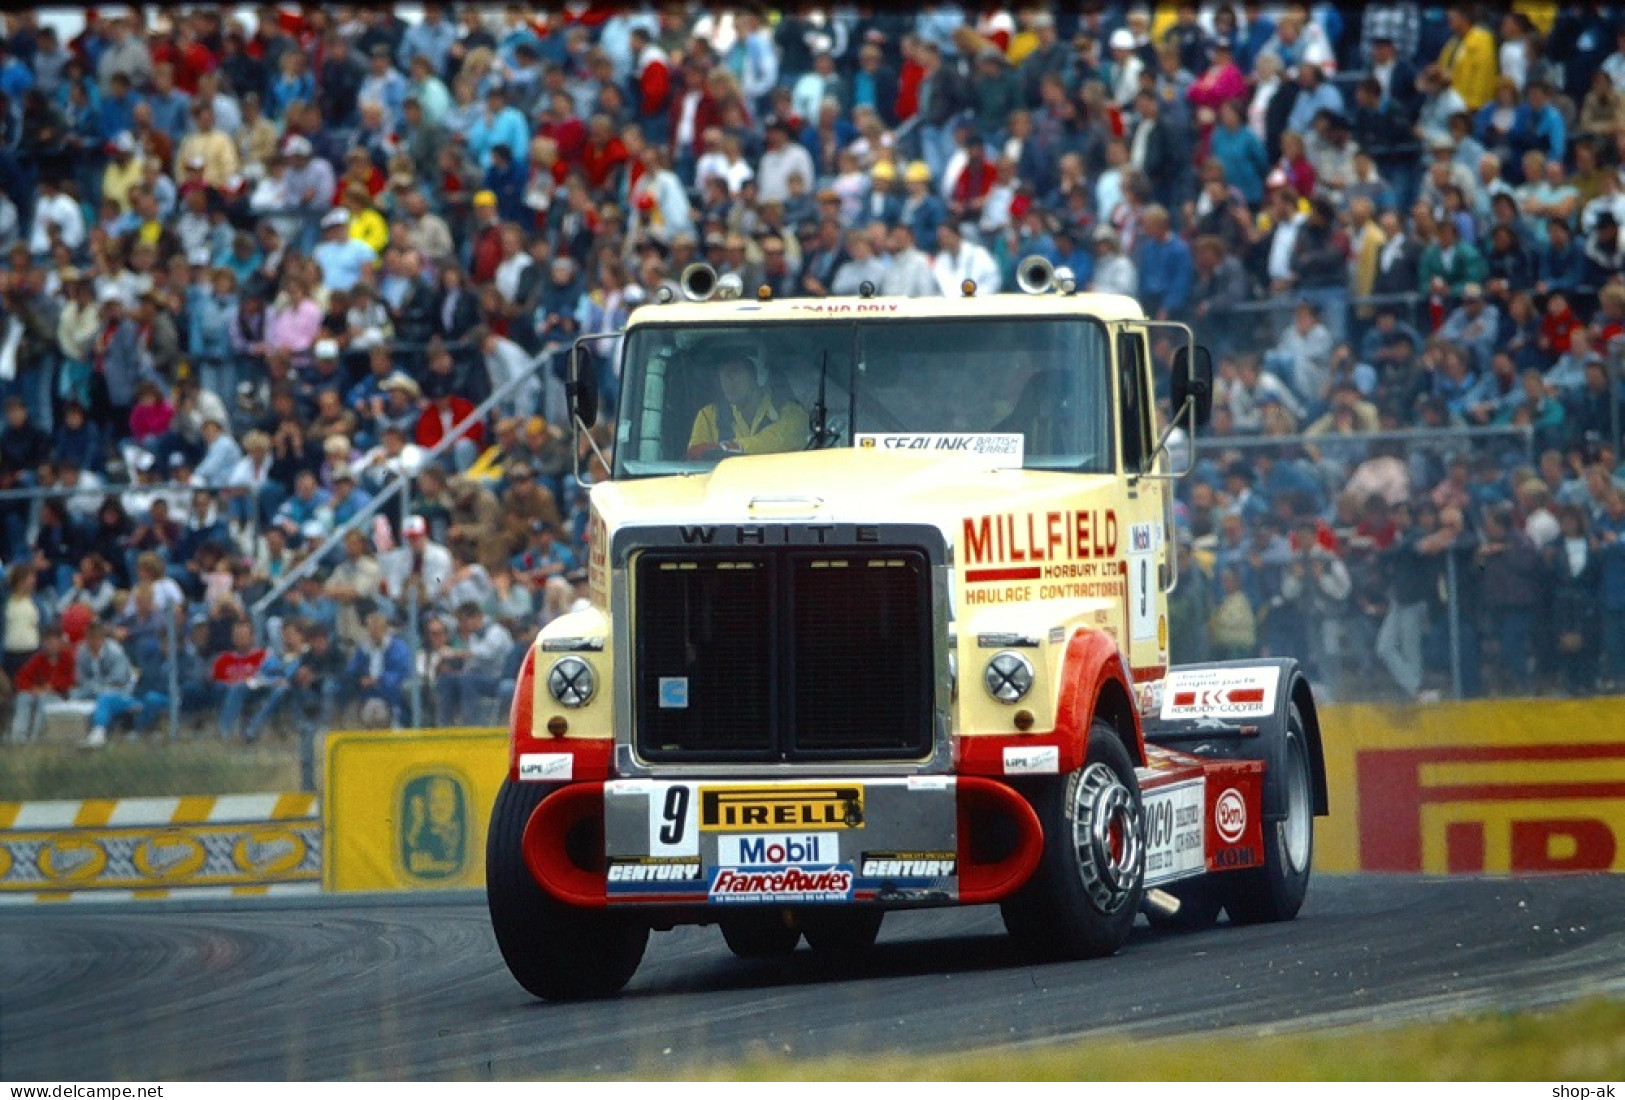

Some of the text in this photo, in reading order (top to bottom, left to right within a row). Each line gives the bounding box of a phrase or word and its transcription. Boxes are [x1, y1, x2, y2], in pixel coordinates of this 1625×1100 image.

[679, 525, 879, 544] WHITE
[962, 508, 1118, 566] MILLFIELD
[1044, 562, 1119, 579] HORBURY LTD
[965, 582, 1120, 605] HAULAGE CONTRACTORS
[1139, 558, 1148, 617] 9
[659, 785, 690, 845] 9
[739, 835, 819, 864] Mobil
[1215, 847, 1255, 867] KONI
[607, 863, 699, 880] CENTURY
[863, 860, 955, 876] CENTURY
[712, 867, 852, 894] FranceRoutes
